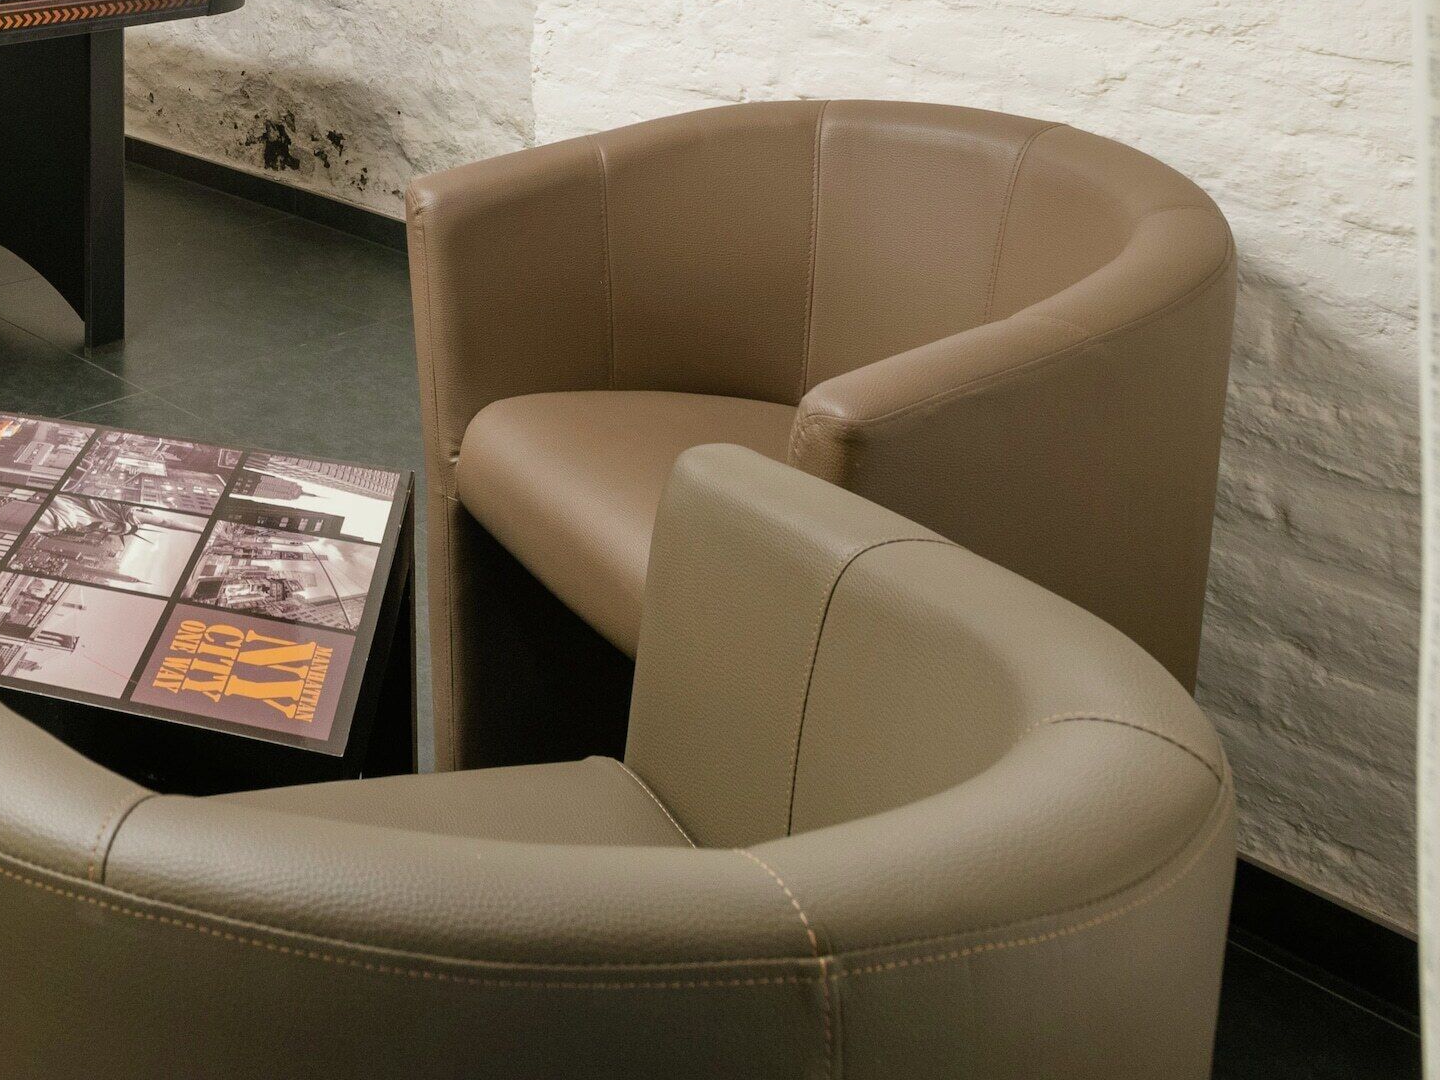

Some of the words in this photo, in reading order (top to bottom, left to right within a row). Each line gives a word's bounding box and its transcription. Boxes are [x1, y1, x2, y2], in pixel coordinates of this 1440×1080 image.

[152, 656, 192, 694] WAY
[170, 620, 207, 654] ONE
[181, 624, 245, 703] CITY
[224, 629, 317, 719] NY
[295, 645, 333, 722] MANHATTAN
